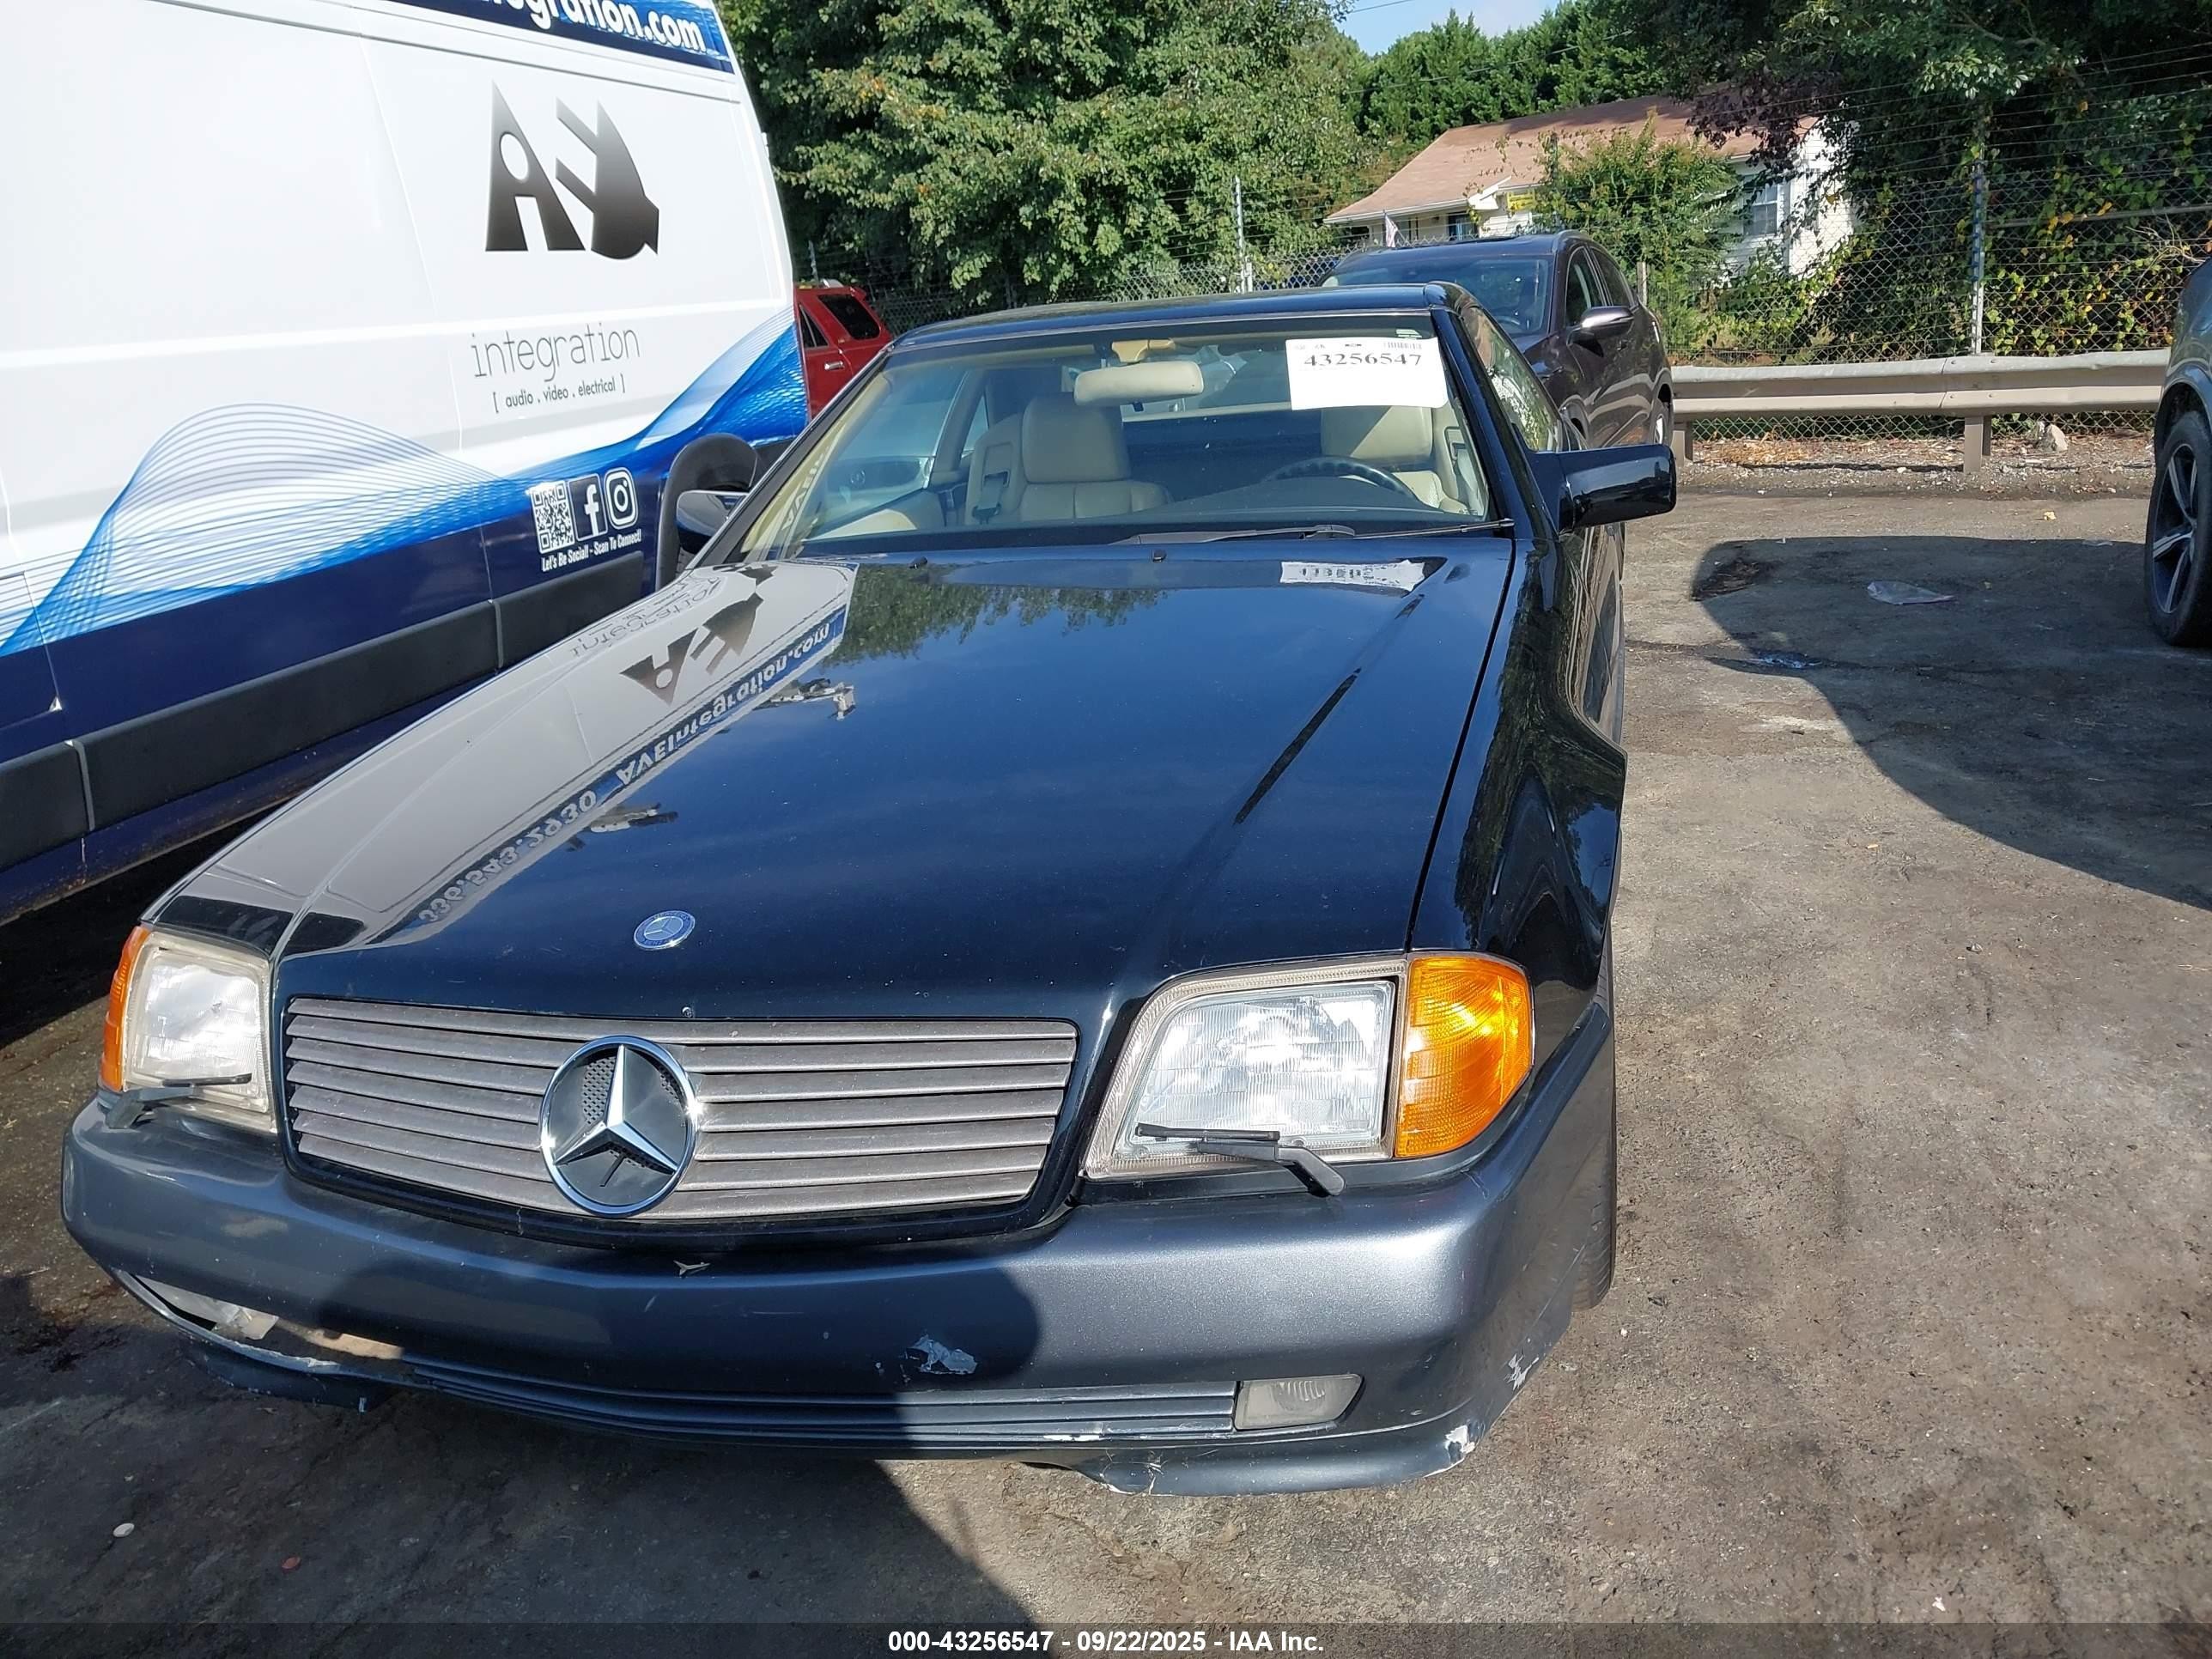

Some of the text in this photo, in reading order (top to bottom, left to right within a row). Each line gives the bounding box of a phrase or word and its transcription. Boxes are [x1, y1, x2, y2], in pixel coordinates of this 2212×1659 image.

[471, 322, 641, 384] integration
[1304, 352, 1422, 367] 43256547
[505, 388, 534, 408] audio
[543, 384, 568, 402] video
[578, 375, 616, 397] electrical
[541, 555, 558, 573] Let's
[557, 552, 568, 567] Be
[593, 541, 610, 556] Scan
[608, 536, 617, 550] To
